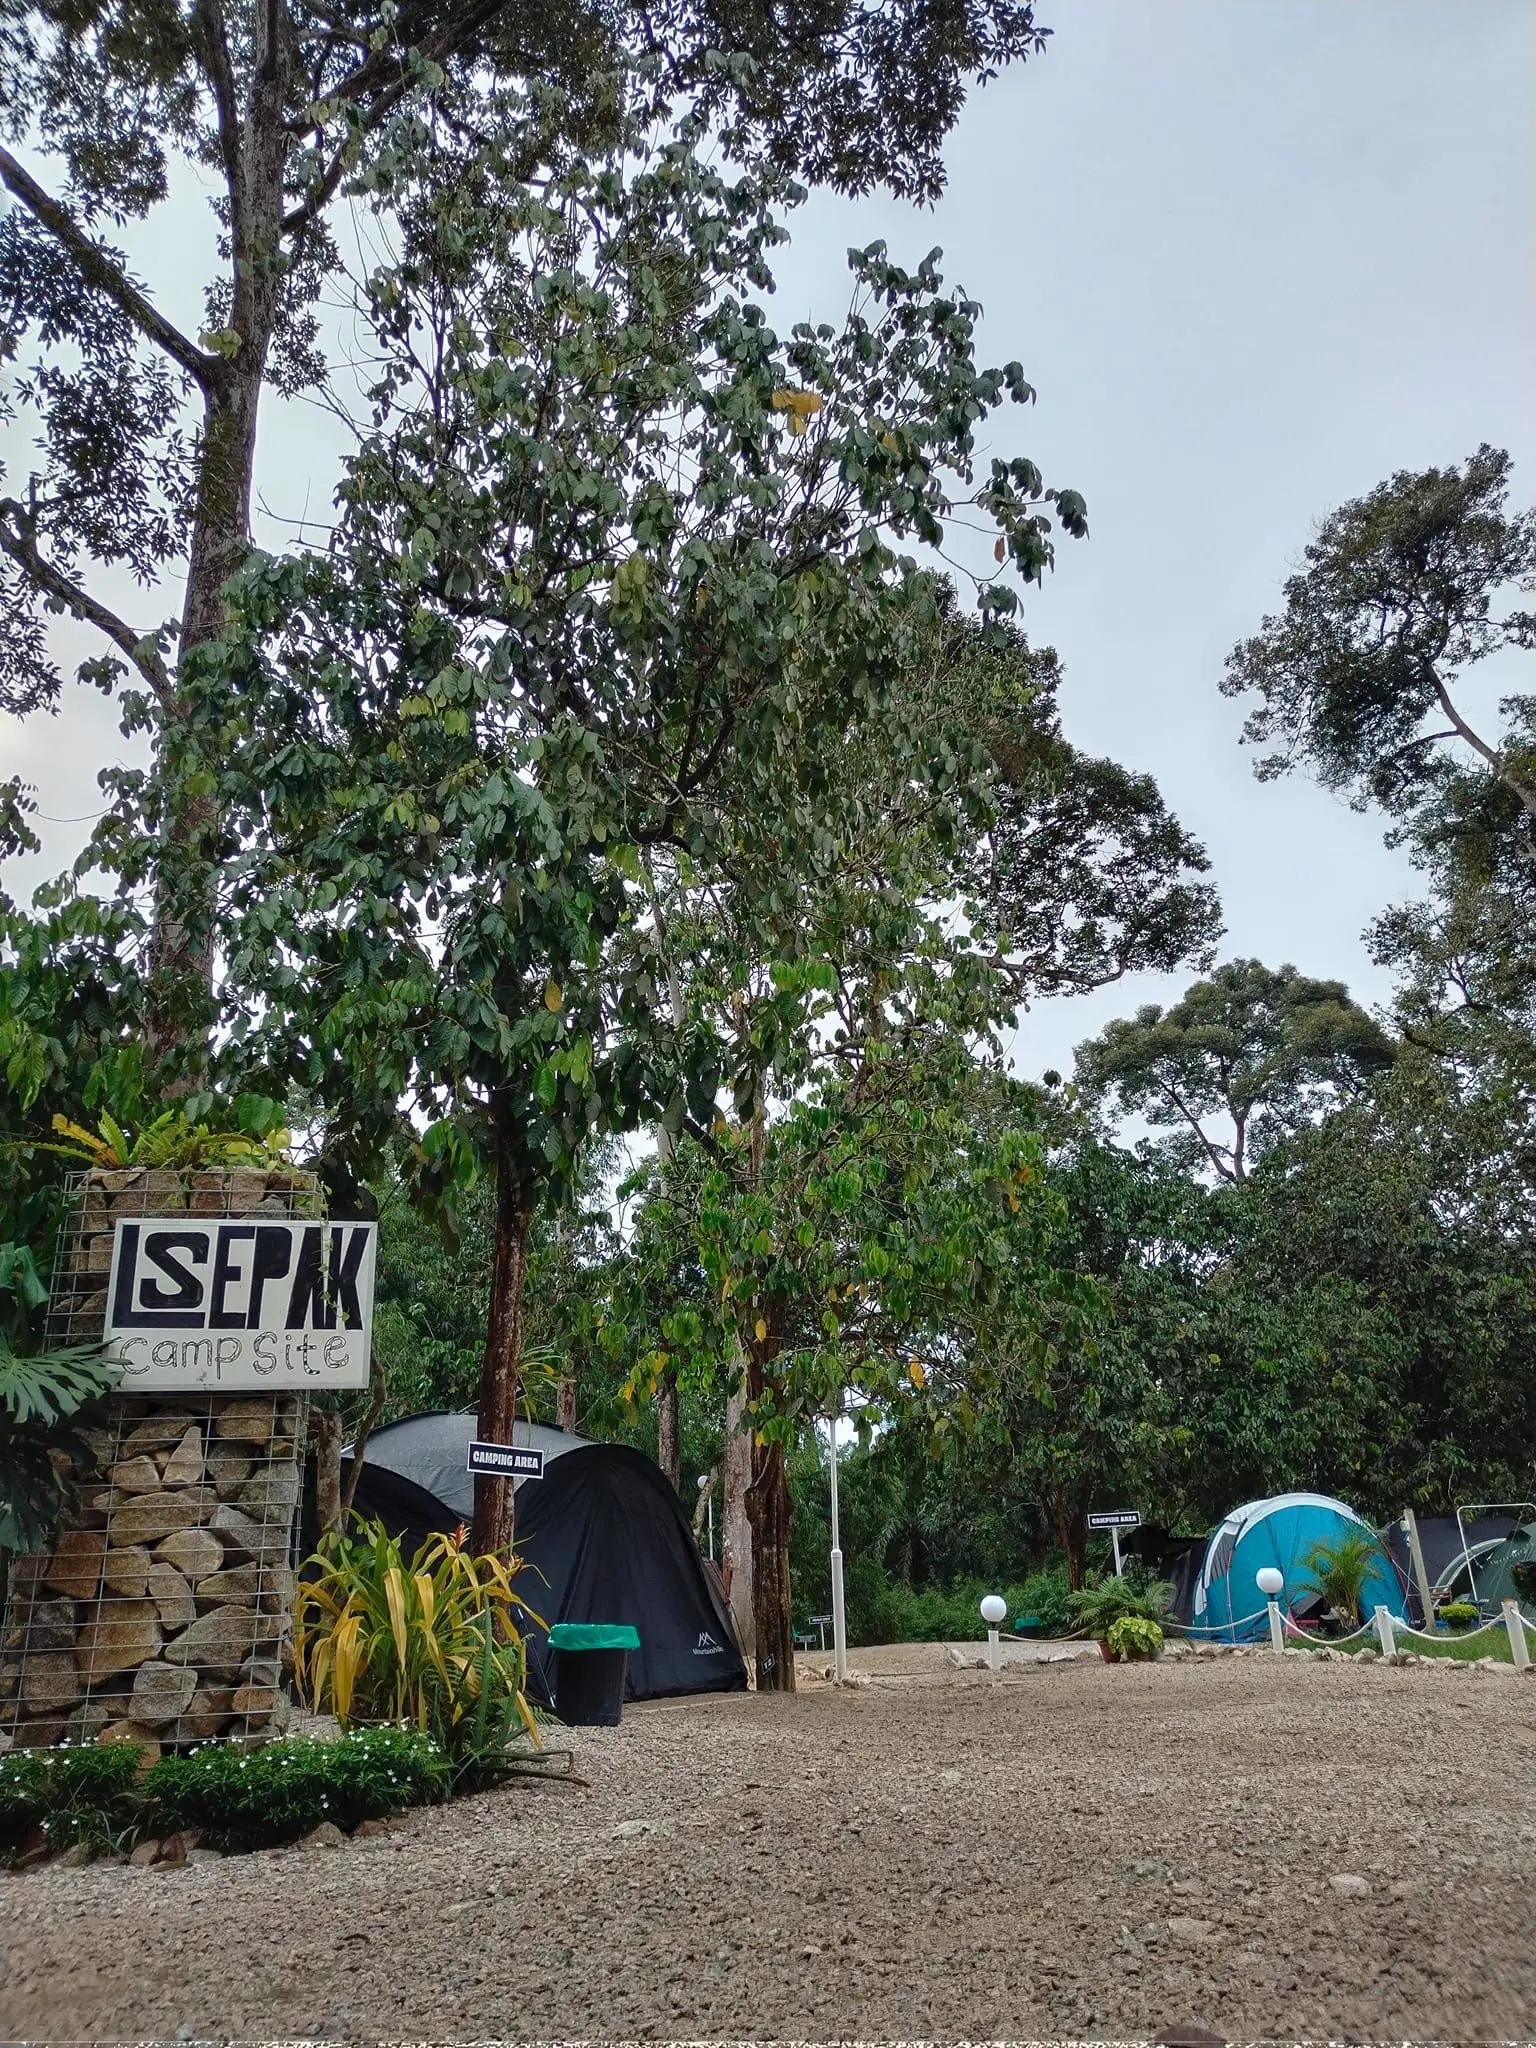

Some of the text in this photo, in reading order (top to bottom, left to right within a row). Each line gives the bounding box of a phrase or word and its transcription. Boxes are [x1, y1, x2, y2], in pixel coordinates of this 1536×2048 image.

[120, 1331, 350, 1380] Camp Site
[472, 1450, 539, 1469] CAMPING AREA
